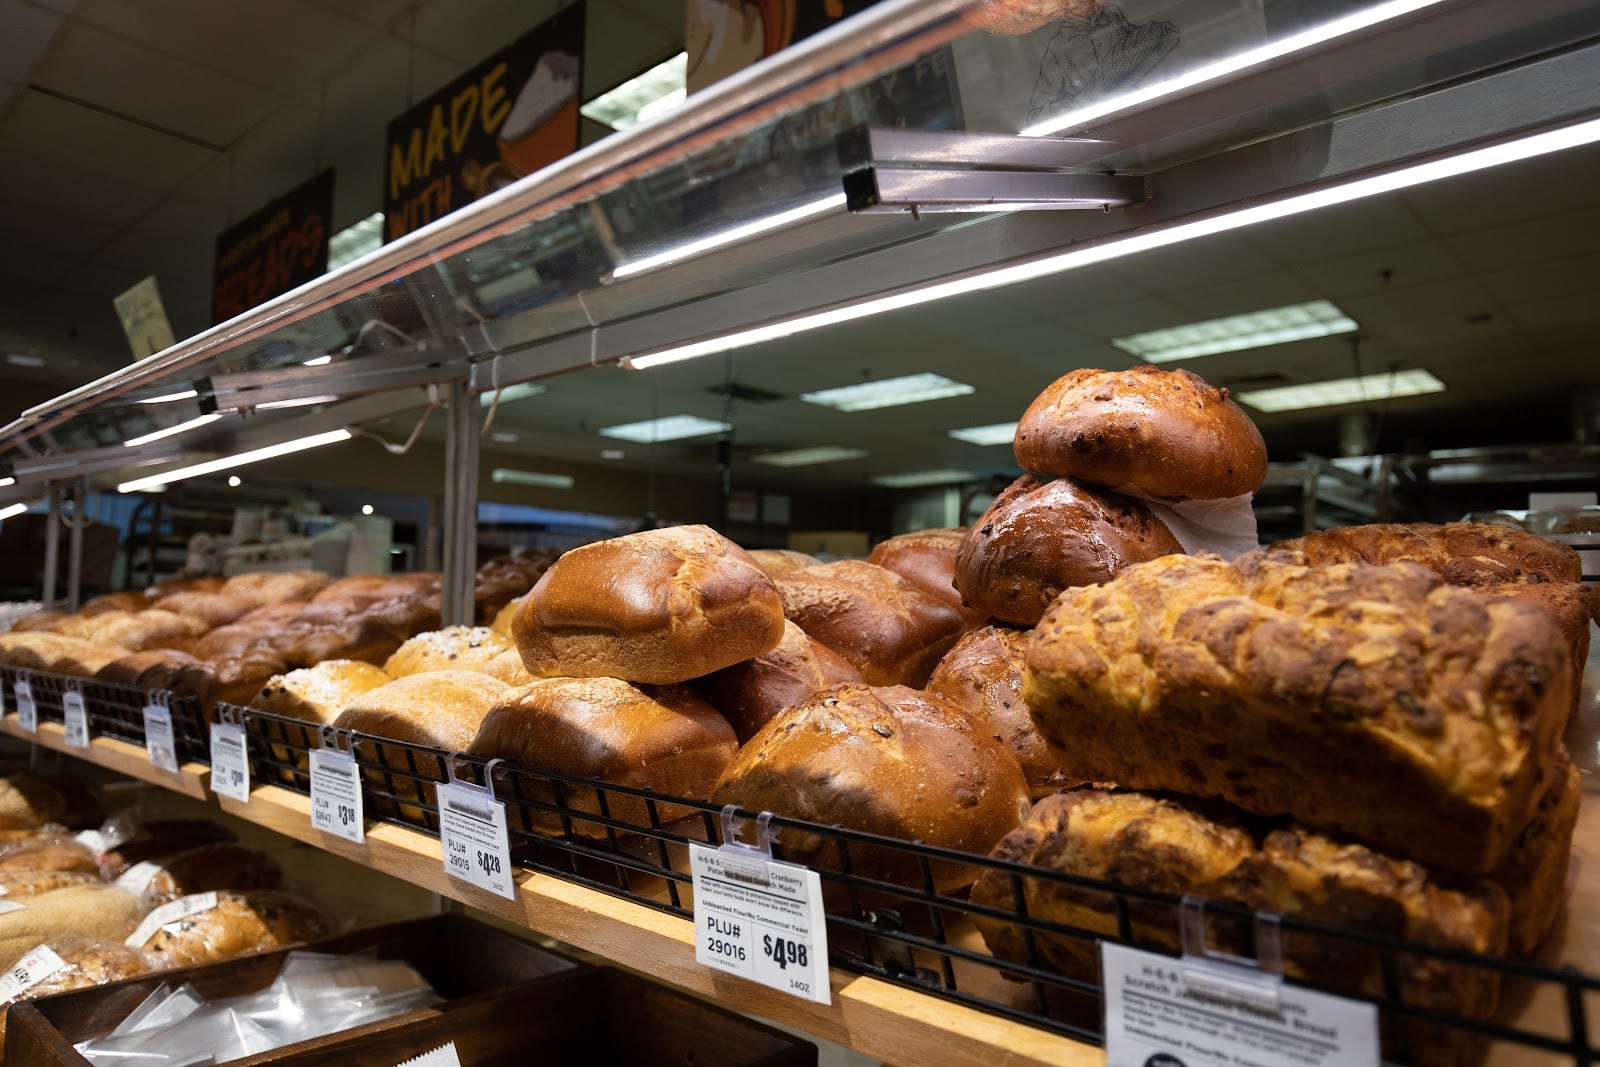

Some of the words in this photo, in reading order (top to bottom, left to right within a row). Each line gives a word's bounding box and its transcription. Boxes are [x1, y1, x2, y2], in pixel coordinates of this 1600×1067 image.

[390, 62, 513, 201] MADE
[389, 173, 453, 241] WITH
[338, 805, 355, 826] $318
[448, 839, 466, 854] PLU#
[450, 854, 470, 871] 29015
[477, 850, 501, 876] $428
[753, 877, 777, 890] Scratch
[778, 884, 796, 895] Made
[770, 872, 801, 887] Cranberry
[722, 885, 745, 895] cranberries
[750, 892, 771, 902] pistachios
[772, 898, 788, 907] topped
[702, 899, 732, 913] Unbleached
[757, 914, 789, 929] Commercial
[792, 924, 808, 934] Yeast
[707, 917, 741, 939] PLU#
[708, 937, 746, 961] 29016
[764, 934, 808, 970] $498
[790, 979, 810, 993] 14OZ
